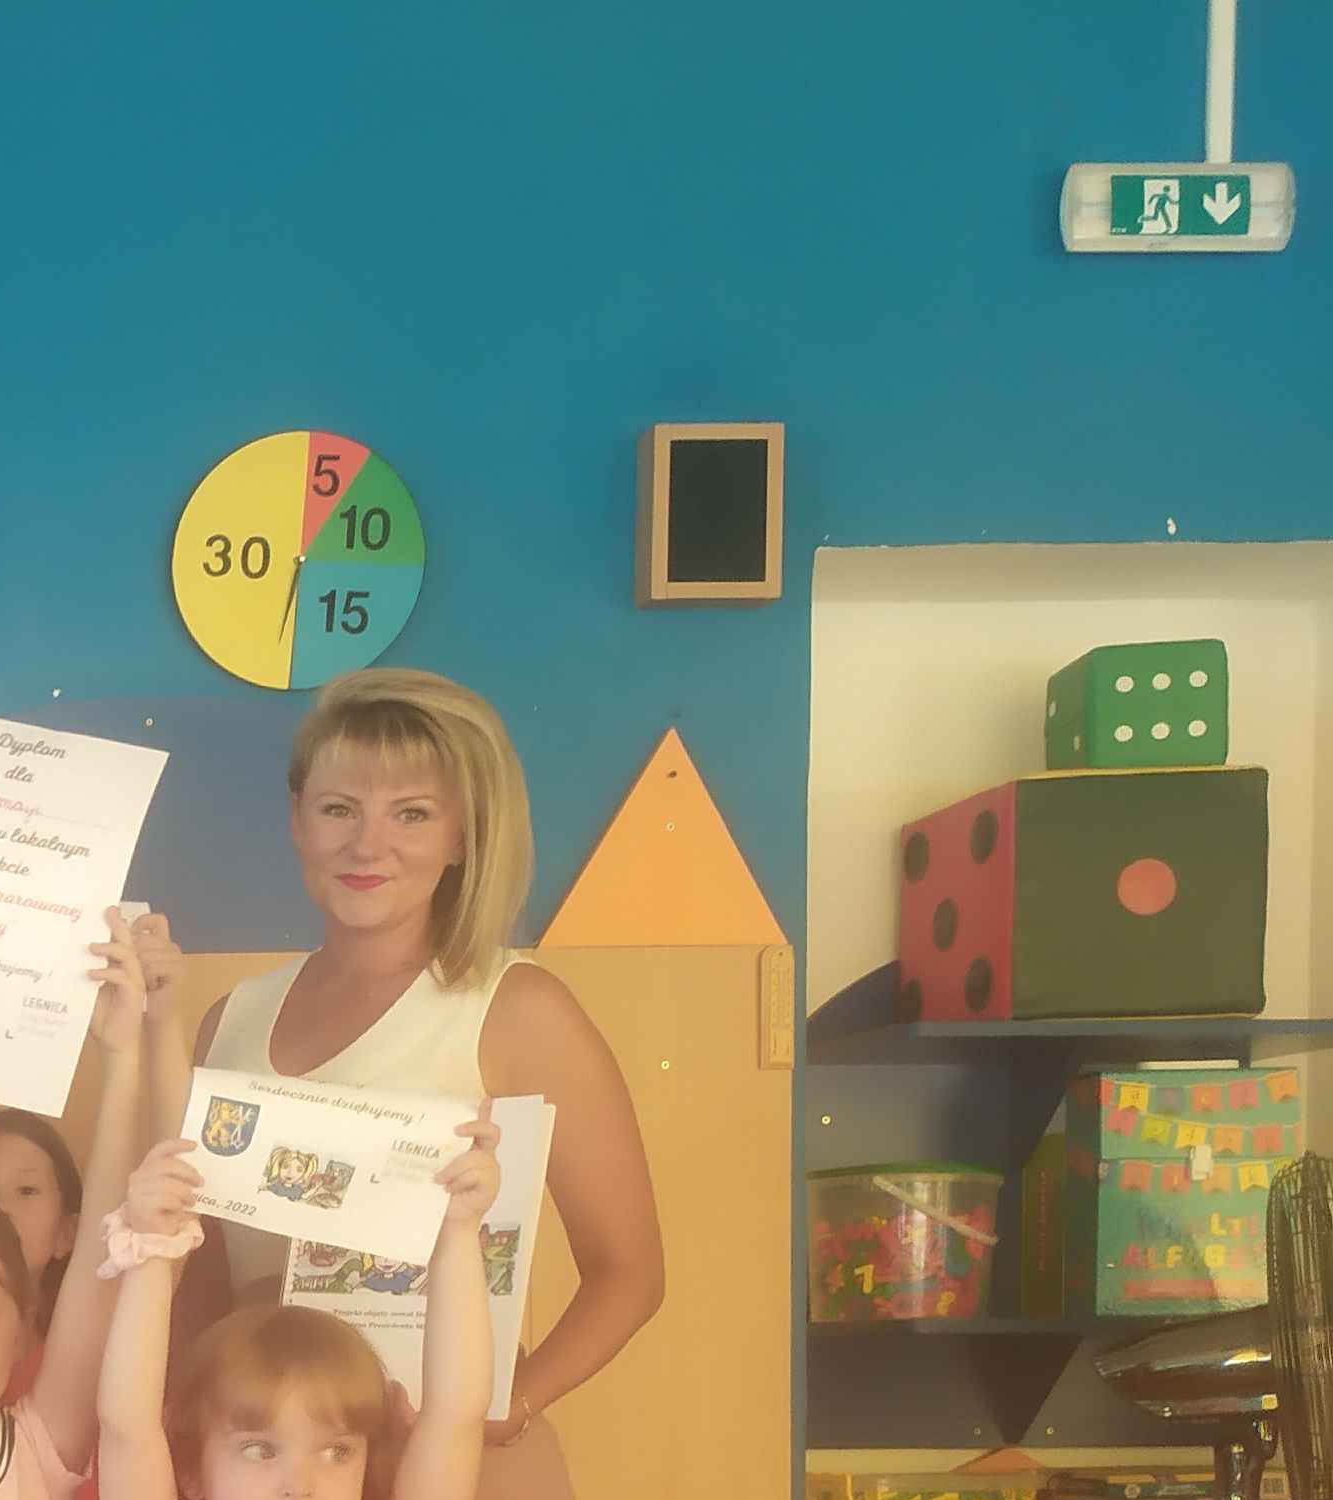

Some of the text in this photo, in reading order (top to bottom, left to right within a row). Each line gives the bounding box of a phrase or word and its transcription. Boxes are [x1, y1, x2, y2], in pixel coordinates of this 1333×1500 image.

[312, 454, 341, 497] 5
[339, 505, 391, 551] 10
[202, 534, 271, 579] 30
[318, 589, 370, 635] 15
[3, 764, 37, 784] dla
[9, 826, 92, 860] lokalnym
[391, 1138, 441, 1160] LEGNICA
[224, 1197, 259, 1217] 2022
